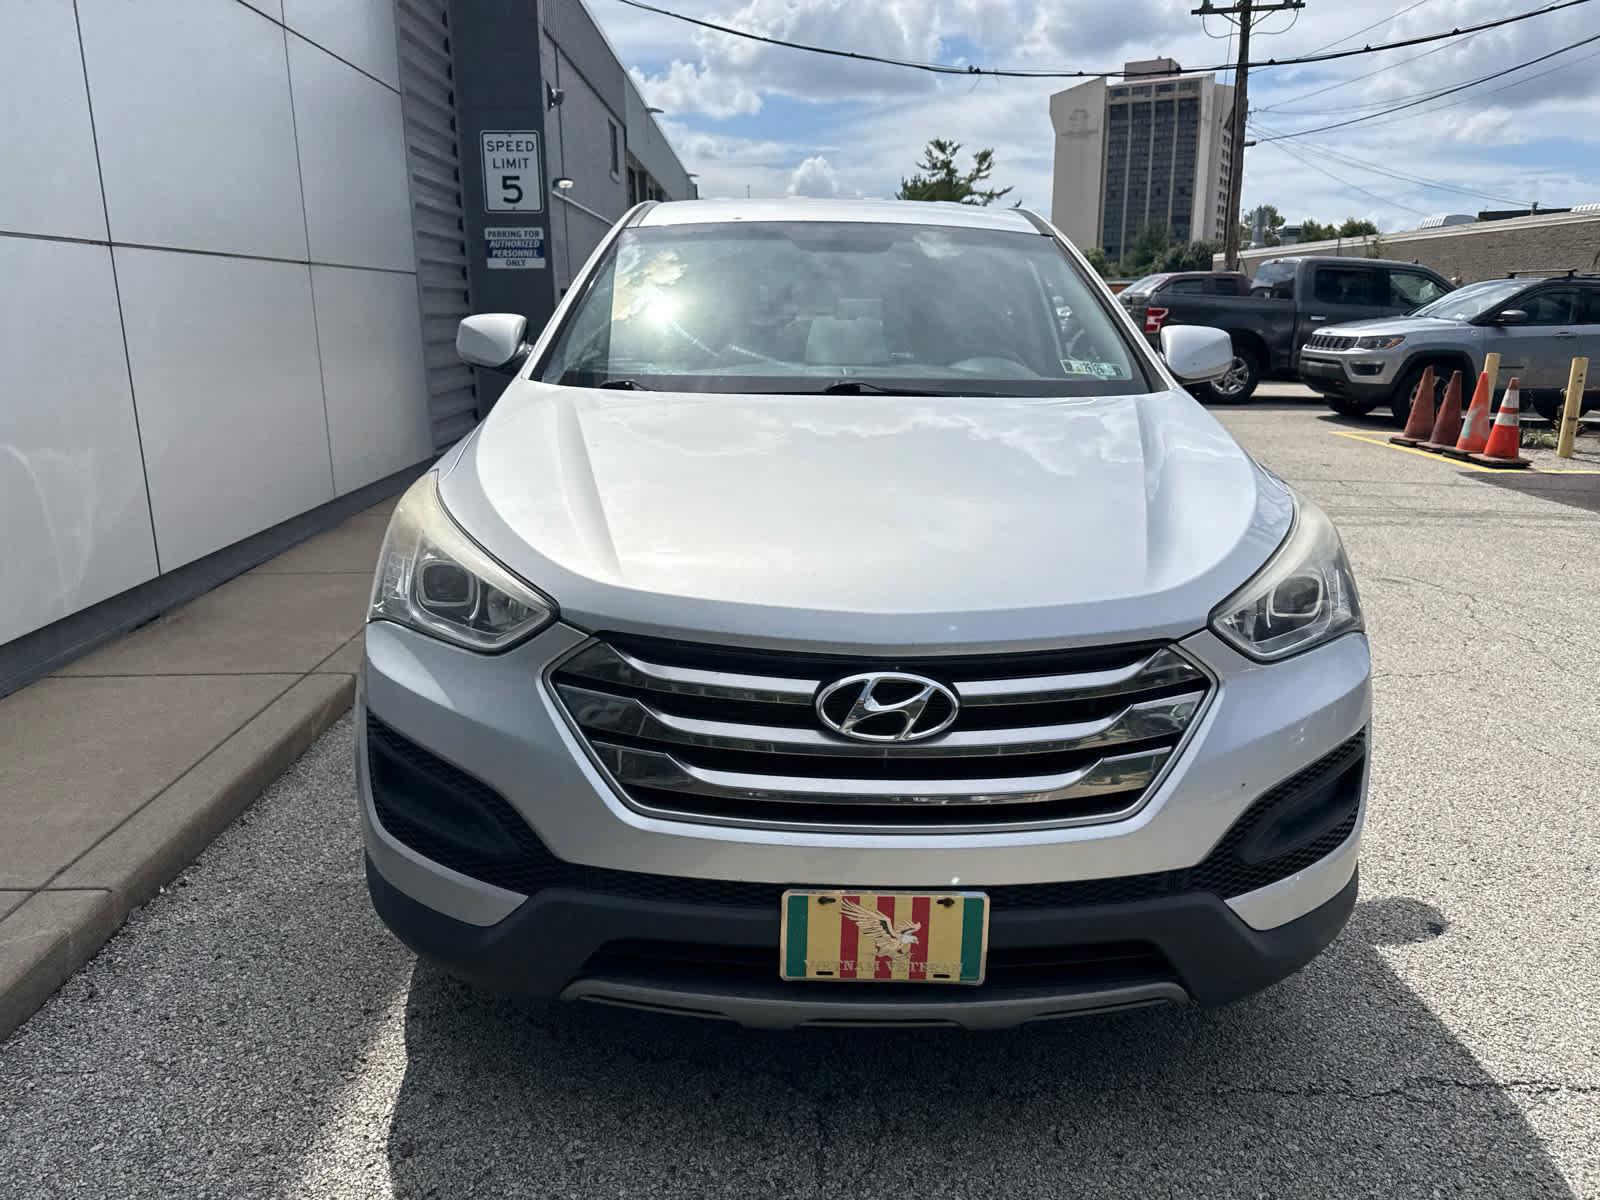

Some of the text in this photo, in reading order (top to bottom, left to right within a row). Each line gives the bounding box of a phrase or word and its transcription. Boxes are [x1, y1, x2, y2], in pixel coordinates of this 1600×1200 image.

[486, 141, 535, 152] SPEED
[492, 158, 529, 169] LIMIT
[502, 175, 523, 204] 5
[487, 230, 540, 238] PARKING FOR
[489, 240, 541, 249] AUTHORIZED
[492, 249, 538, 258] PERSONNEL
[505, 259, 526, 267] ONLY
